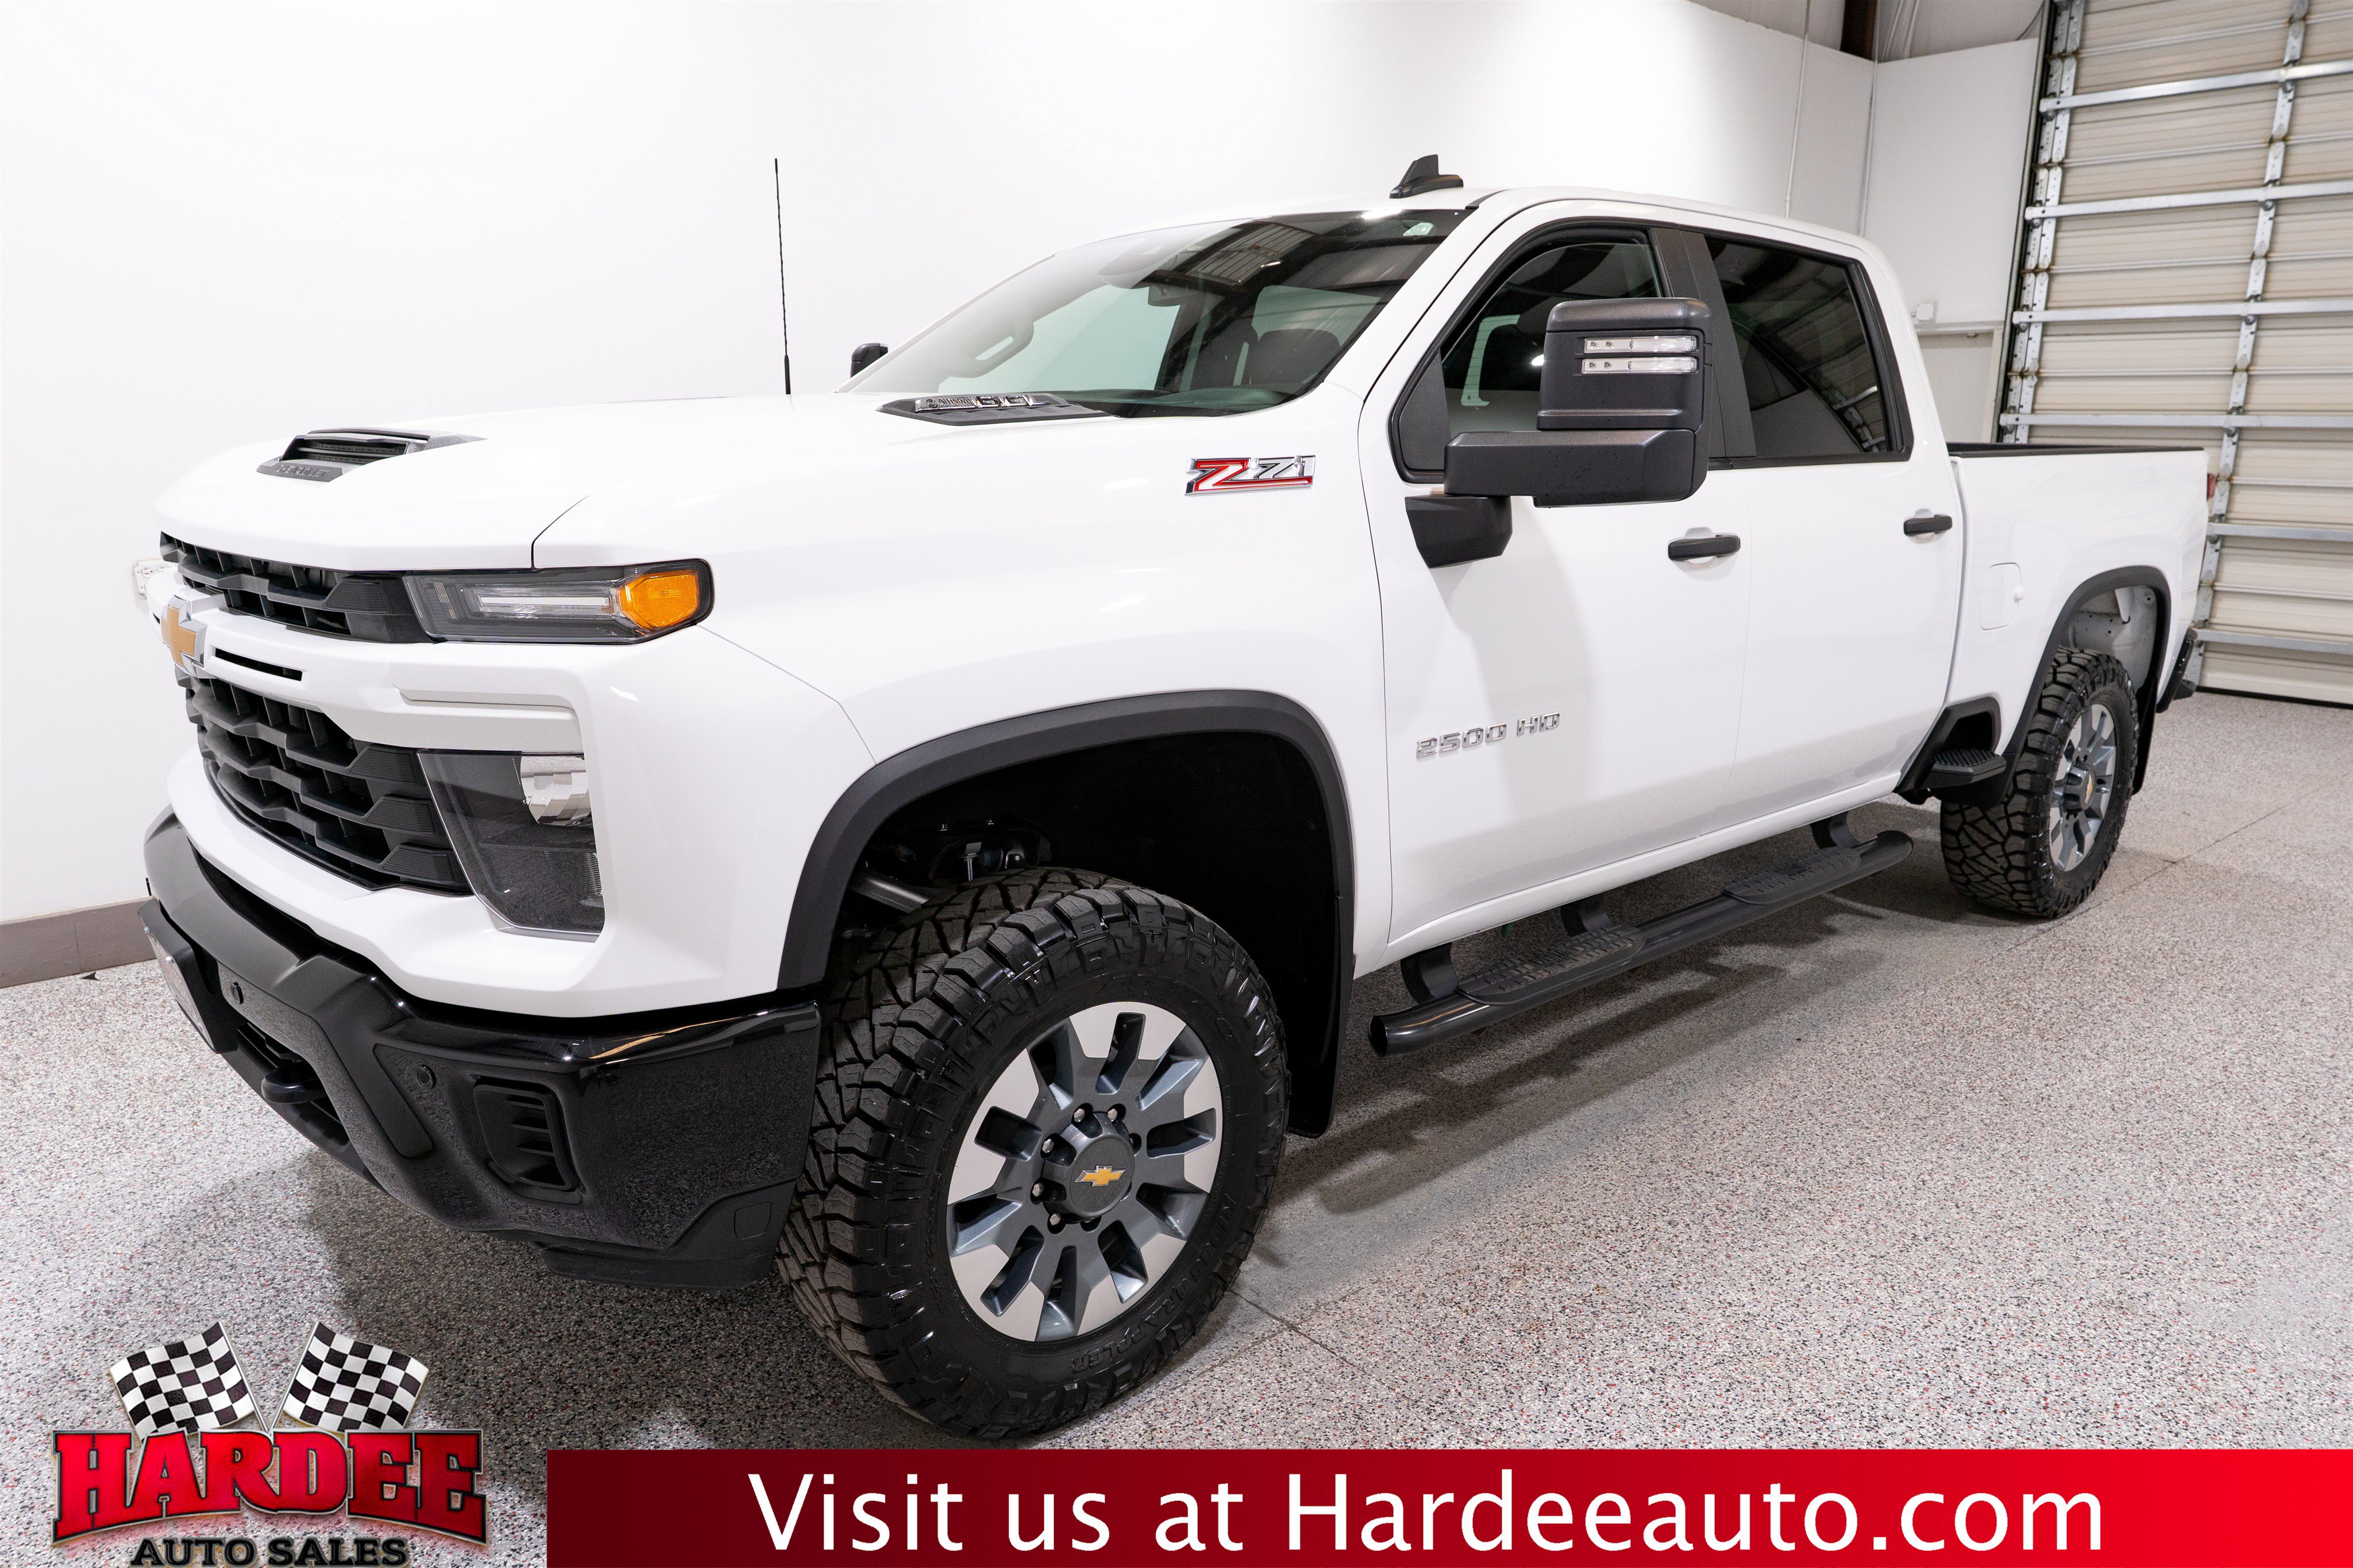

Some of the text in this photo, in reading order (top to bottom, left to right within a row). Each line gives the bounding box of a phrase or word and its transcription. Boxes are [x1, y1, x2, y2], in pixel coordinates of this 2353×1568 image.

[275, 464, 330, 477] CHEVROLET
[1185, 455, 1316, 495] Z71
[1416, 711, 1560, 759] 2500 HD
[1071, 1277, 1191, 1374] GRAPPLER
